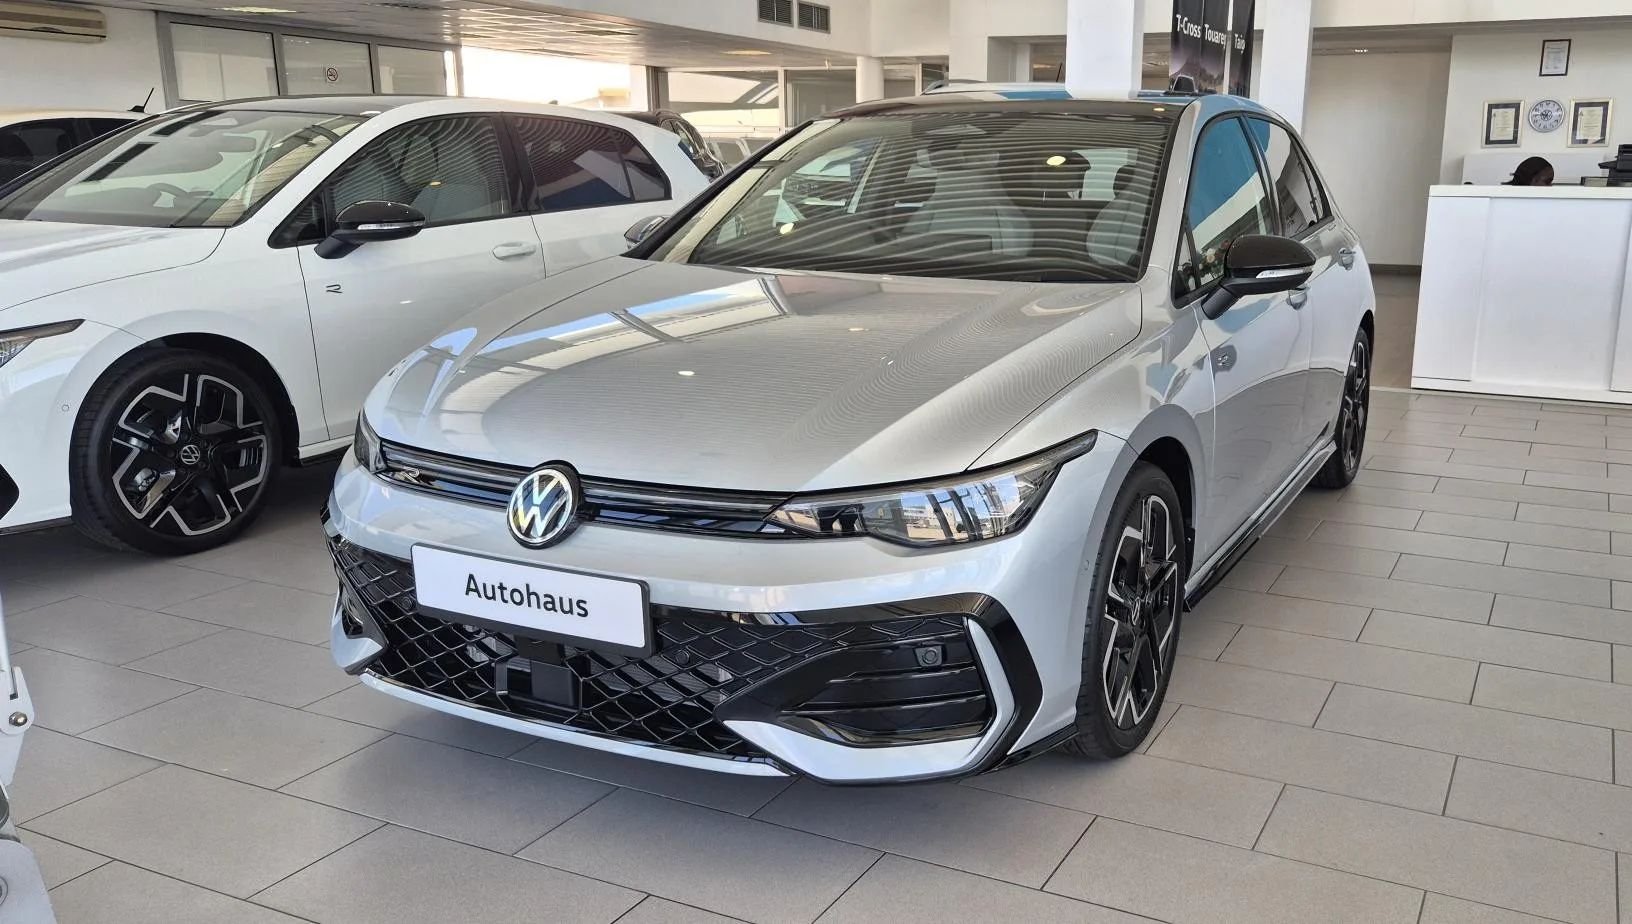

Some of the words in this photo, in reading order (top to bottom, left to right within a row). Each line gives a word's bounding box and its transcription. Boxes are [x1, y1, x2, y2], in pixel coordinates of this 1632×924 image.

[1176, 14, 1201, 38] T-Cross
[510, 470, 571, 543] VW
[465, 573, 589, 618] Autohaus
